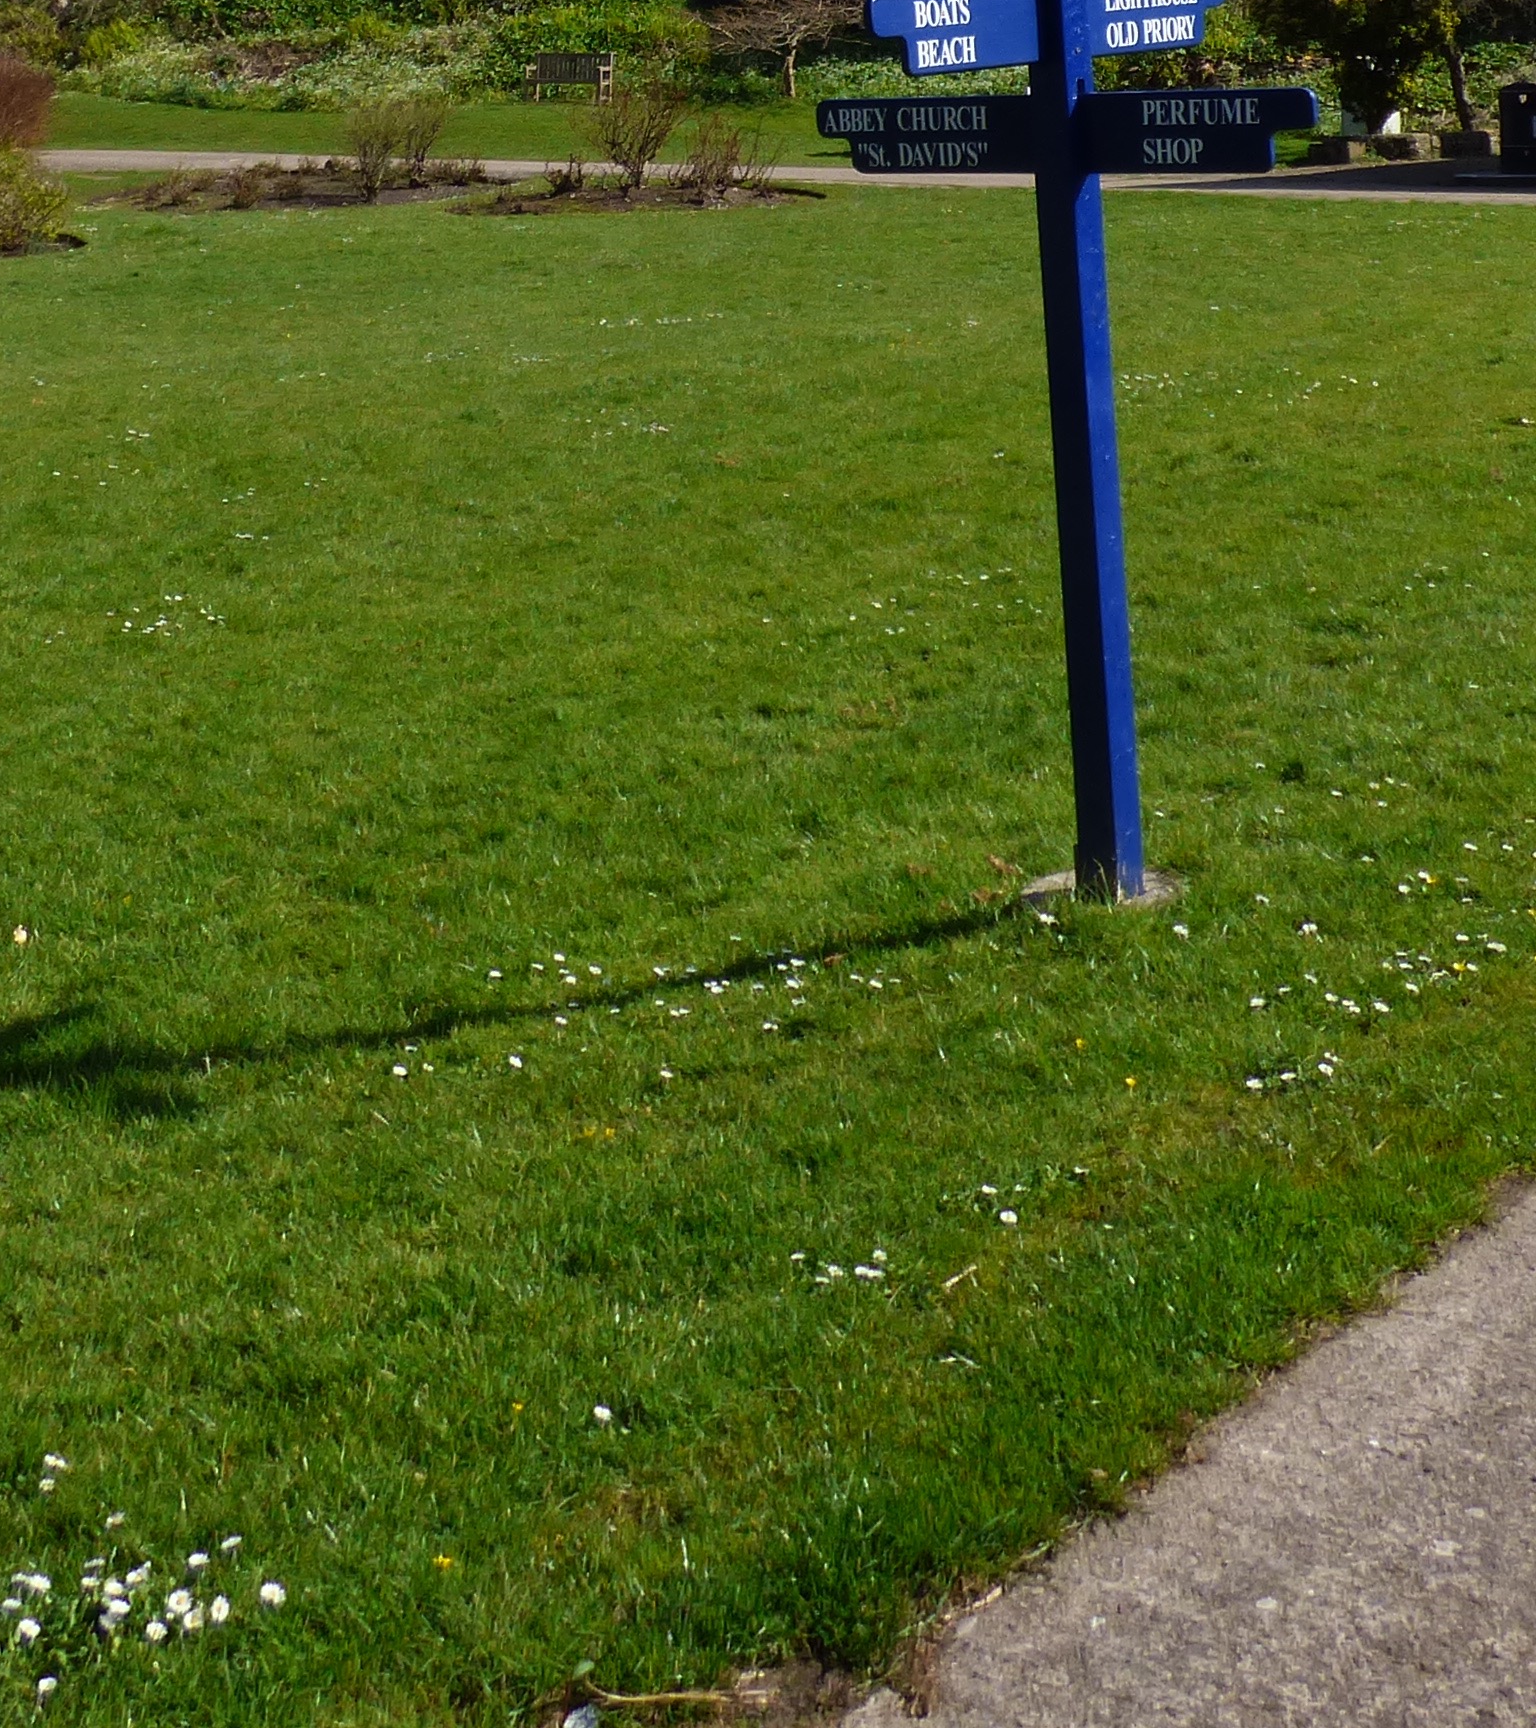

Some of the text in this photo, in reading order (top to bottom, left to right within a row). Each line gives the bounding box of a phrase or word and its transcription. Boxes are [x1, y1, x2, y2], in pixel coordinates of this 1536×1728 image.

[1106, 15, 1196, 48] OLD PRIORY
[916, 35, 976, 69] BEACH
[824, 105, 987, 132] ABBEY CHURCH
[1141, 98, 1260, 126] PERFUME
[857, 141, 988, 167] "St. DAVID'S"
[1143, 137, 1204, 165] SHOP
